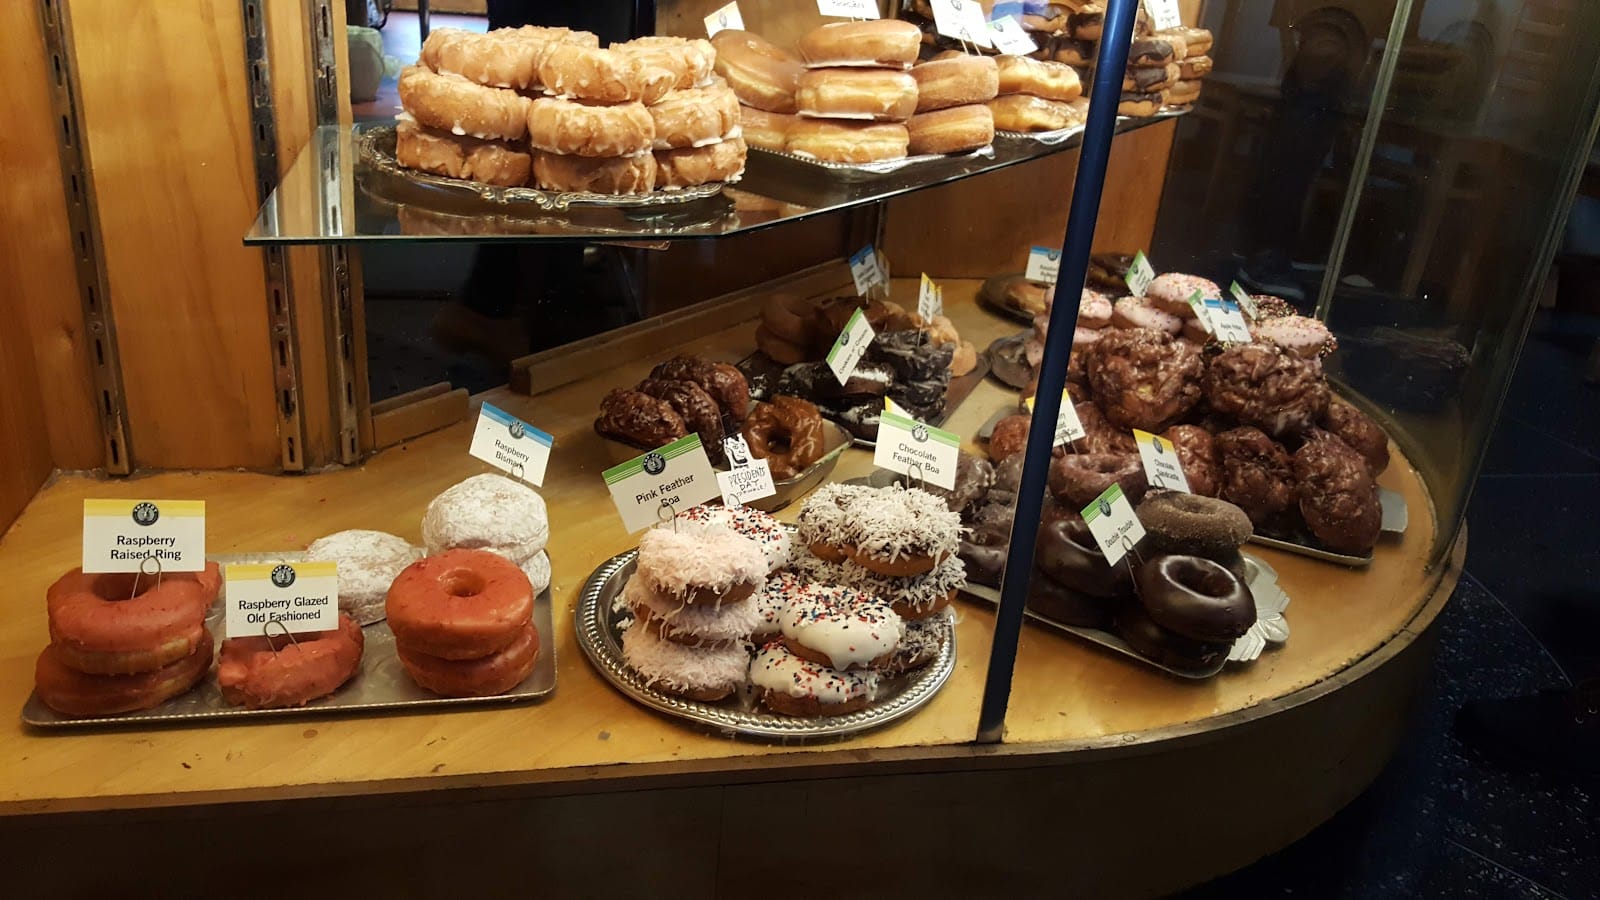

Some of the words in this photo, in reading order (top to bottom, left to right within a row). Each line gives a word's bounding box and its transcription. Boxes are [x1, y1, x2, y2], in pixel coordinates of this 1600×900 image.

[494, 439, 530, 462] Raspberry
[898, 442, 937, 462] Chocolate
[892, 451, 923, 469] Feather
[924, 462, 940, 474] Boa
[635, 489, 658, 505] Pink
[659, 474, 695, 495] Feather
[116, 535, 176, 548] Raspberry
[110, 549, 151, 560] Raised
[155, 549, 182, 561] Ring
[238, 599, 291, 611] Raspberry
[294, 595, 328, 607] Glazed
[246, 613, 266, 624] Old
[269, 609, 321, 622] Fashioned
